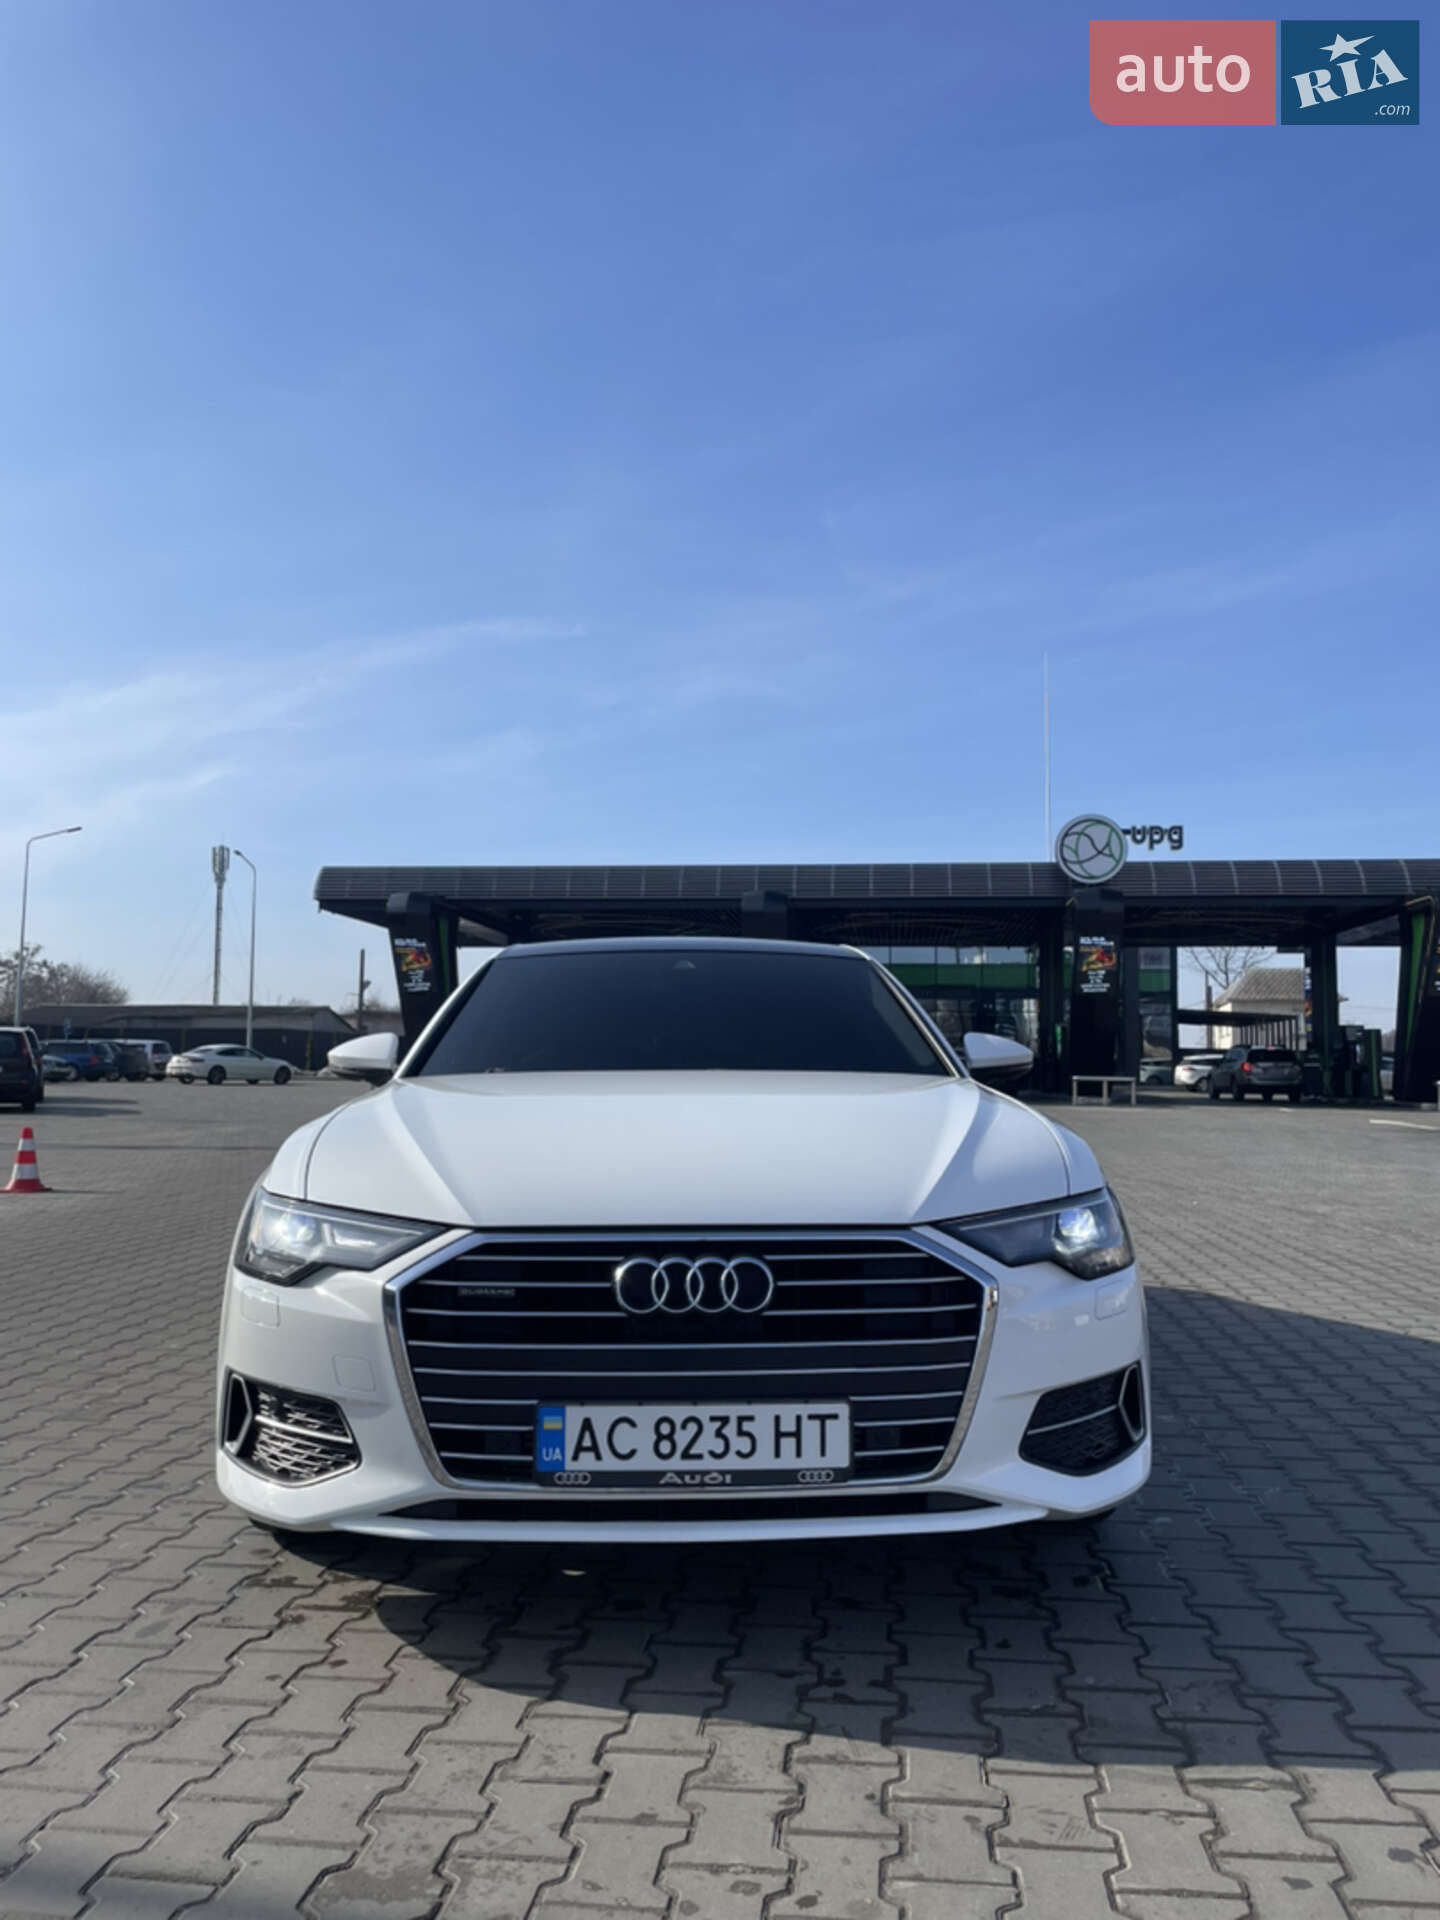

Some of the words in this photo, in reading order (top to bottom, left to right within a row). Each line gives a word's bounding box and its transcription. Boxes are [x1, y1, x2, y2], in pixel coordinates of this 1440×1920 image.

[1131, 825, 1184, 850] upg
[571, 1415, 638, 1462] AC
[653, 1415, 757, 1461] 8235
[774, 1413, 840, 1460] HT
[542, 1447, 563, 1462] UA
